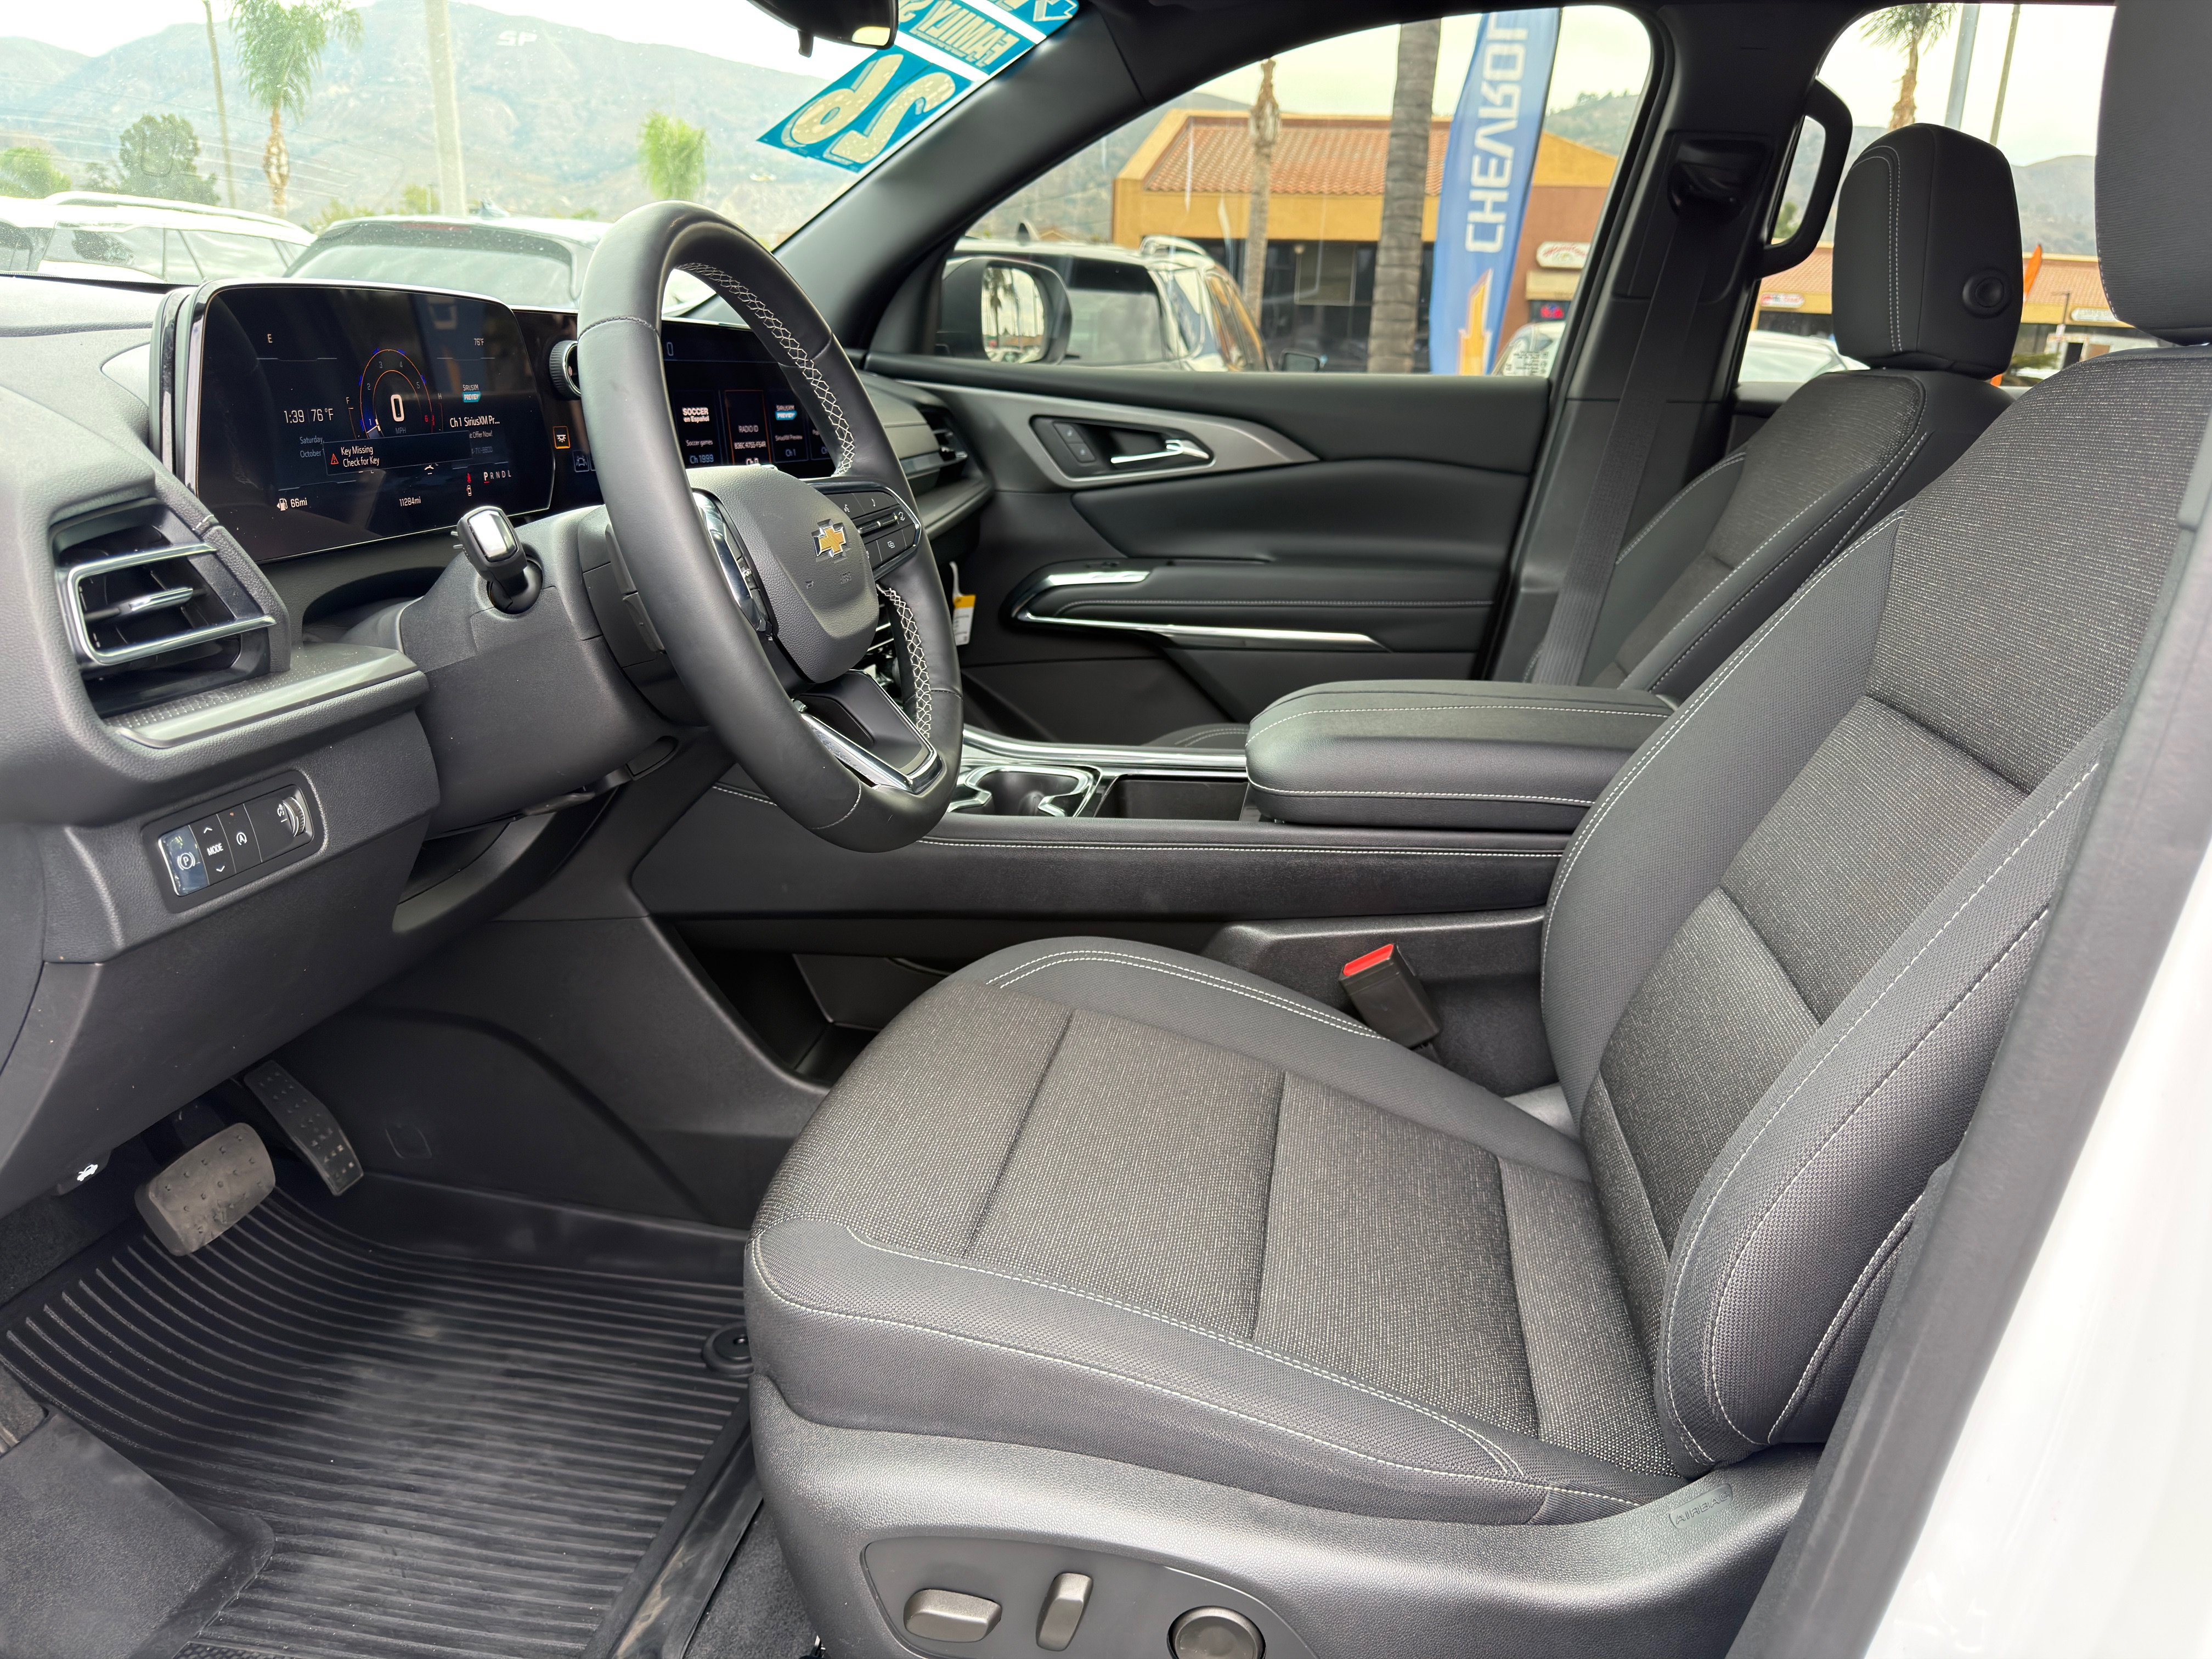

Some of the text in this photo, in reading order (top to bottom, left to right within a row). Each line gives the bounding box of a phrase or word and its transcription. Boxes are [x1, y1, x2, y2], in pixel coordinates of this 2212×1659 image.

[268, 334, 273, 343] E
[391, 394, 405, 422] 0
[682, 407, 709, 416] SOCCER
[284, 409, 305, 424] 1:39
[450, 417, 458, 428] Ch
[459, 417, 462, 427] 1
[464, 415, 488, 427] SiriusXM
[691, 415, 710, 424] Español
[300, 449, 321, 458] October
[341, 445, 374, 457] Key Missing
[343, 457, 360, 467] Check
[369, 456, 380, 466] Key
[690, 454, 714, 464] Ch 1999
[483, 472, 488, 481] P
[290, 498, 308, 508] 66mi
[399, 496, 421, 507] 11284mi
[207, 843, 224, 856] MODE
[1676, 1492, 1730, 1525] AIRBAG
